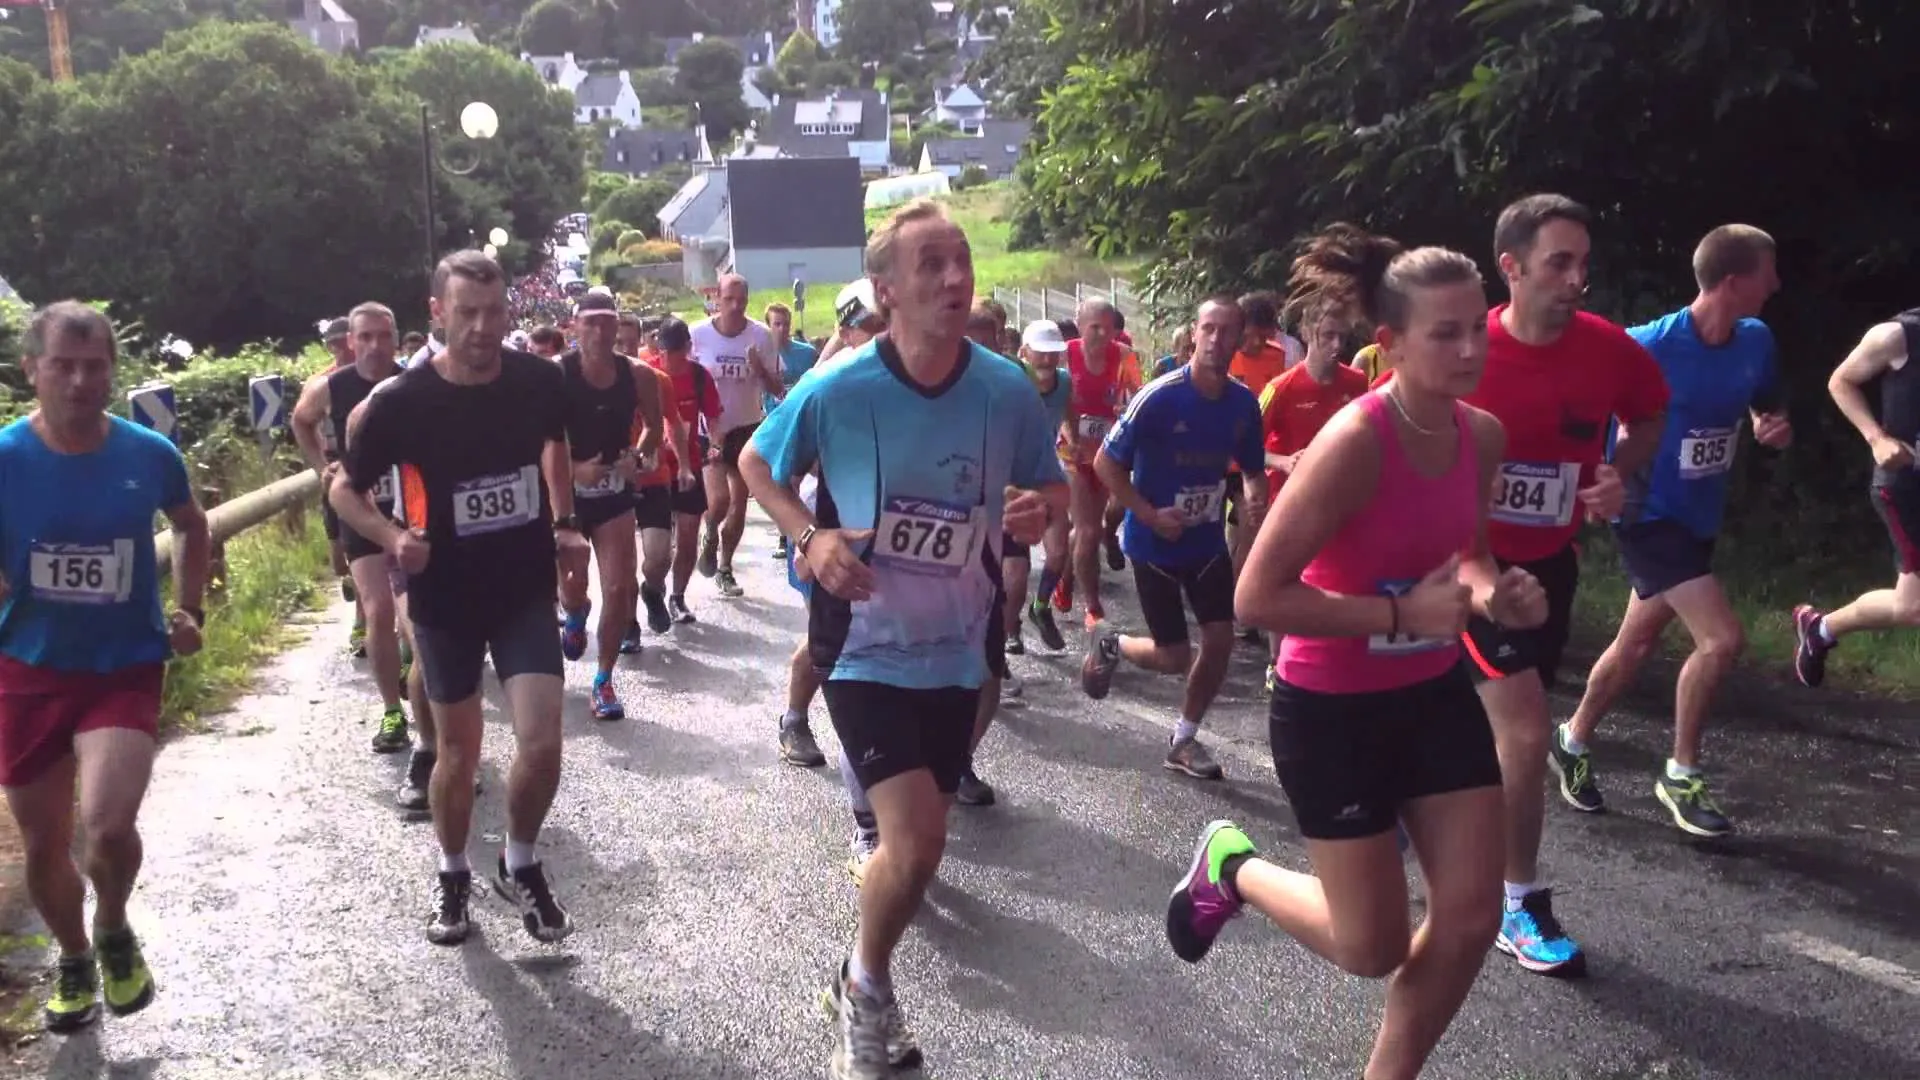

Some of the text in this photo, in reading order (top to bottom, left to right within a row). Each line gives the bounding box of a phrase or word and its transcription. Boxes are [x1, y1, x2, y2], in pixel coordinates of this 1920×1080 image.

[1692, 438, 1726, 467] 835
[466, 488, 516, 520] 938
[891, 519, 954, 560] 678
[48, 558, 103, 589] 156
